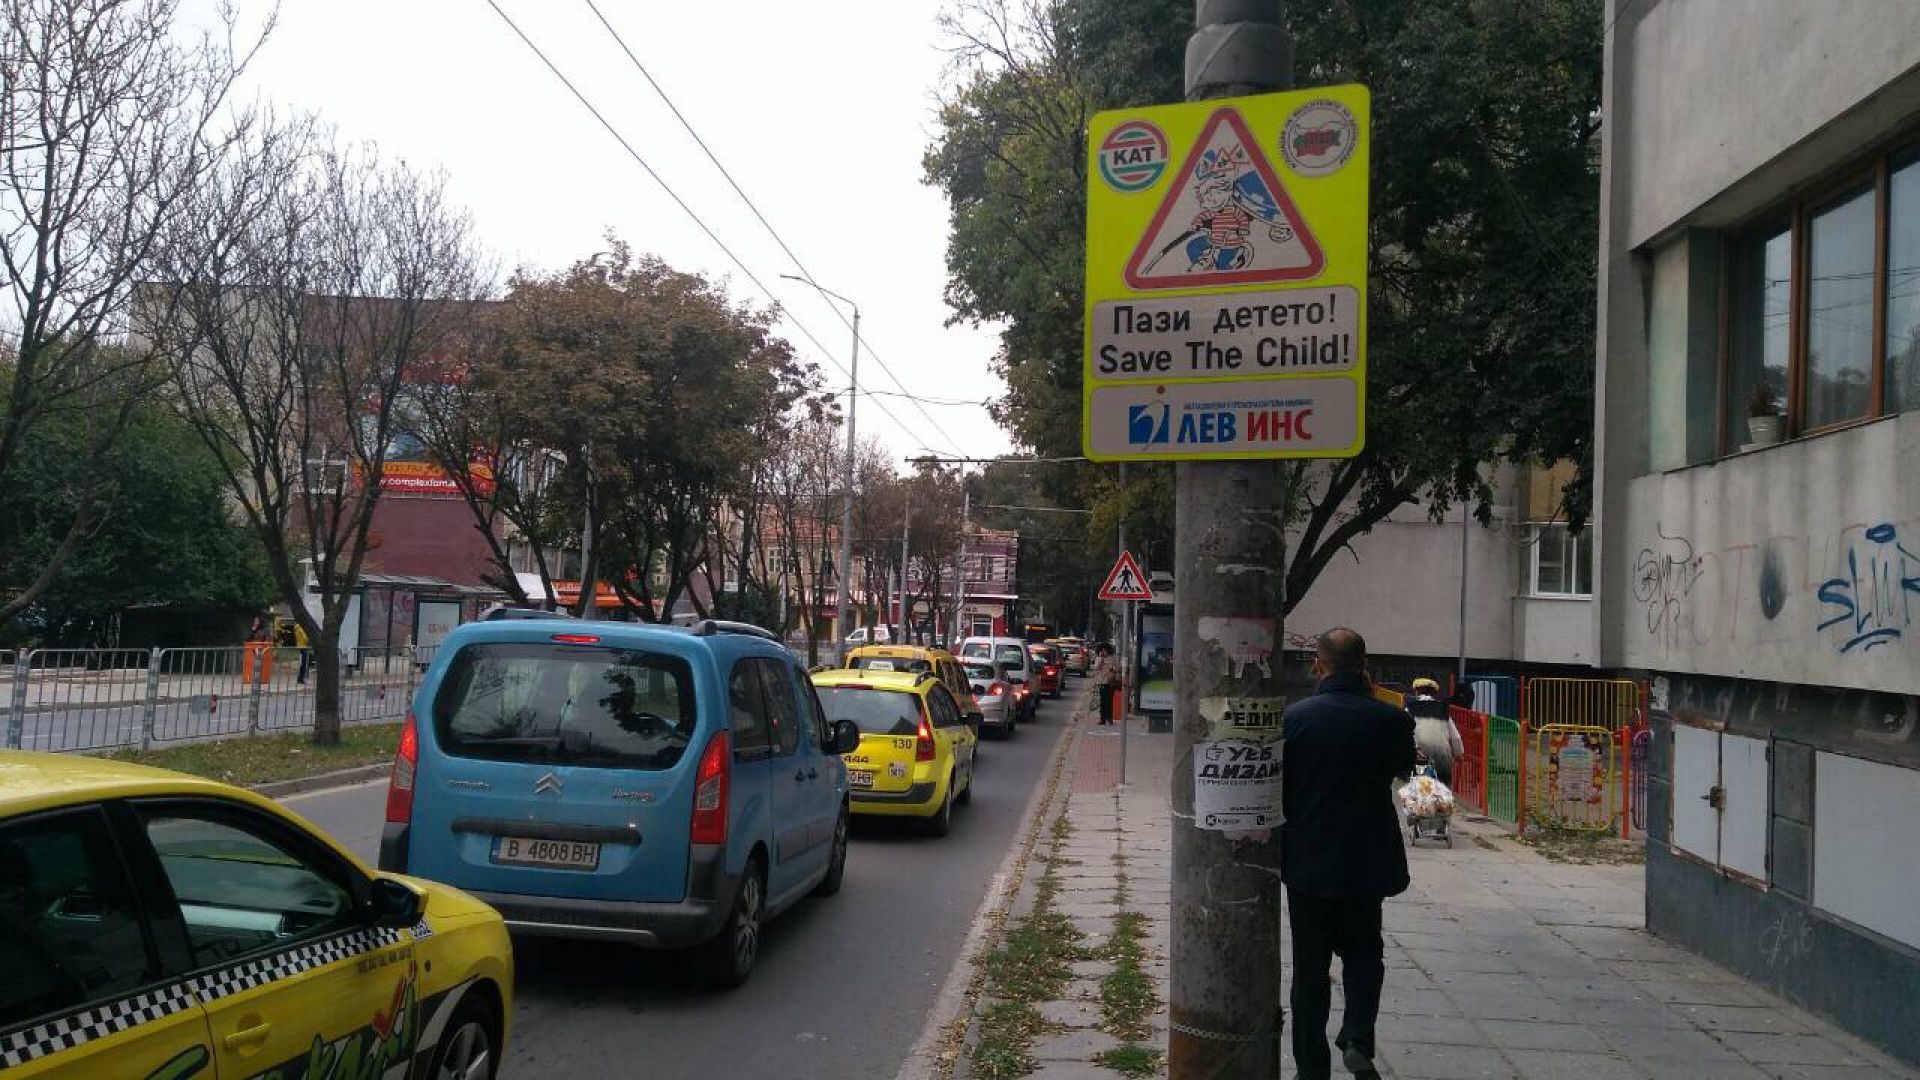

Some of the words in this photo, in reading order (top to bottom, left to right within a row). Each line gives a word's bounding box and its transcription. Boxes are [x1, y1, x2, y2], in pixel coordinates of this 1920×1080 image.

[1112, 147, 1155, 165] КАТ
[1113, 305, 1191, 335] Пази
[1213, 293, 1336, 334] детето!
[1099, 344, 1172, 374] Save
[1185, 339, 1243, 370] The
[1257, 334, 1350, 368] Child!
[1176, 410, 1237, 444] ЛЕВ
[1247, 408, 1314, 442] ИНС
[892, 739, 912, 749] 130
[1227, 746, 1273, 761] УЕБ
[508, 839, 520, 858] B
[527, 841, 570, 862] 4808
[571, 843, 596, 863] BH
